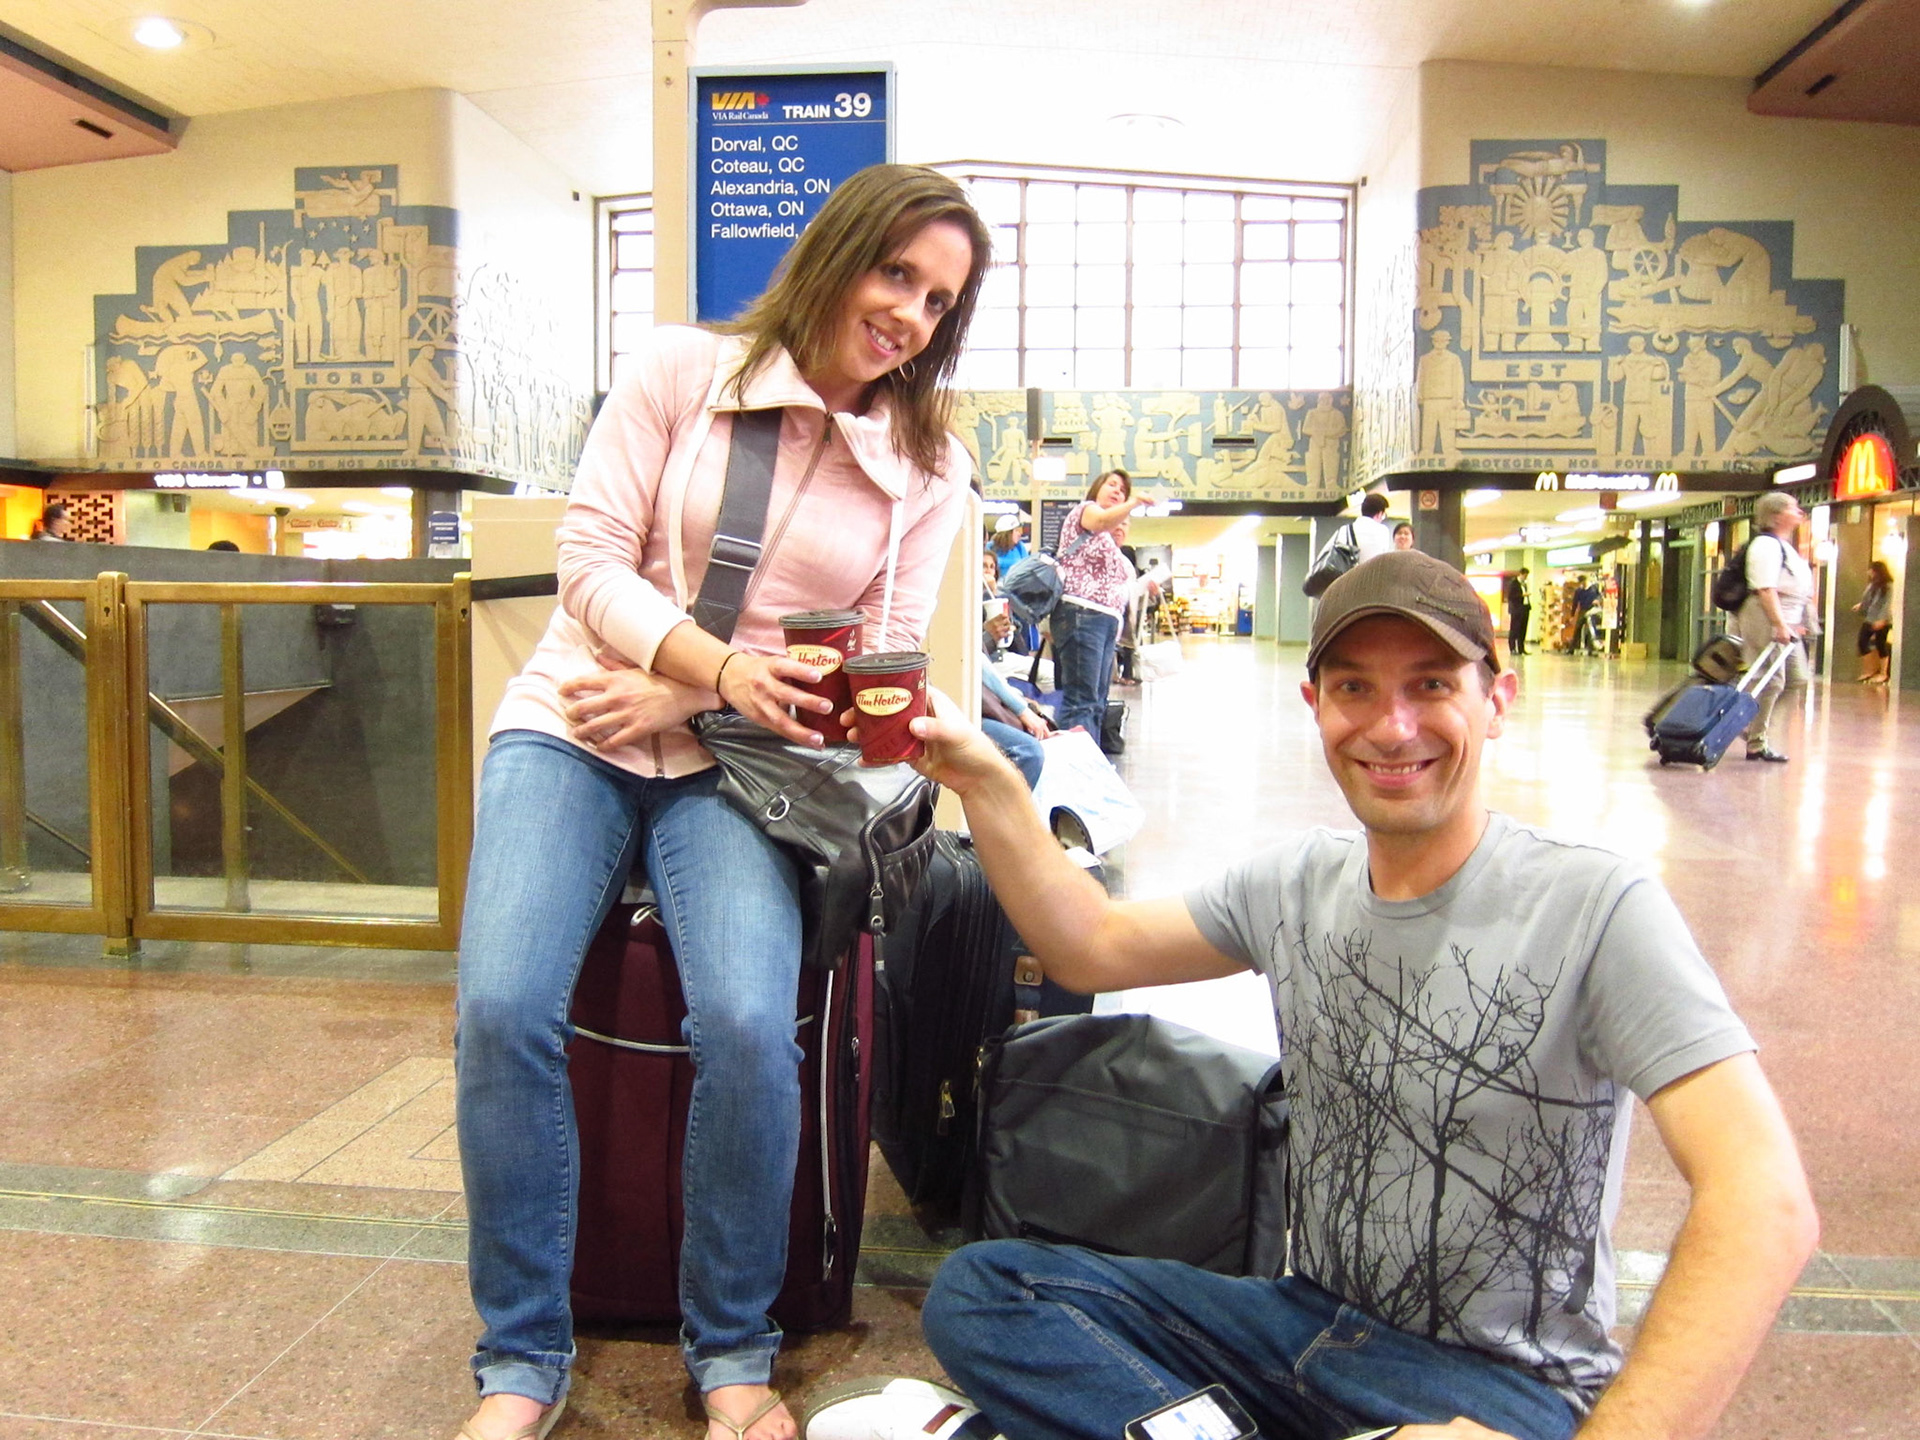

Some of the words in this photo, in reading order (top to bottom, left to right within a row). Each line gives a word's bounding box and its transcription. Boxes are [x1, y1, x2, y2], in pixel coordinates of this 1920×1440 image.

[711, 92, 755, 110] VIA
[782, 105, 831, 119] TRAIN
[834, 93, 872, 118] 39
[712, 112, 728, 121] VIA
[728, 112, 743, 121] Rail
[743, 111, 769, 120] Canada
[711, 136, 766, 153] Dorval,
[771, 135, 799, 152] QC
[711, 158, 773, 175] Coteau,
[778, 156, 805, 173] QC
[710, 180, 799, 196] Alexandria,
[803, 178, 831, 194] ON
[710, 202, 772, 218] Ottawa,
[777, 201, 804, 216] ON
[711, 223, 799, 240] Fallowfield,
[305, 371, 386, 385] NORD
[1505, 363, 1567, 378] EST
[172, 460, 224, 470] CANADA
[308, 459, 325, 469] DE
[337, 458, 364, 469] NOS
[1461, 457, 1554, 469] PROTEGERA
[1568, 458, 1599, 469] NOS
[1615, 459, 1674, 470] FOYERS
[1690, 459, 1709, 471] ET
[984, 488, 1020, 498] CROIX
[1046, 488, 1069, 498] TON
[1173, 490, 1197, 499] UNE
[1281, 490, 1305, 500] DES
[857, 693, 873, 707] Tim
